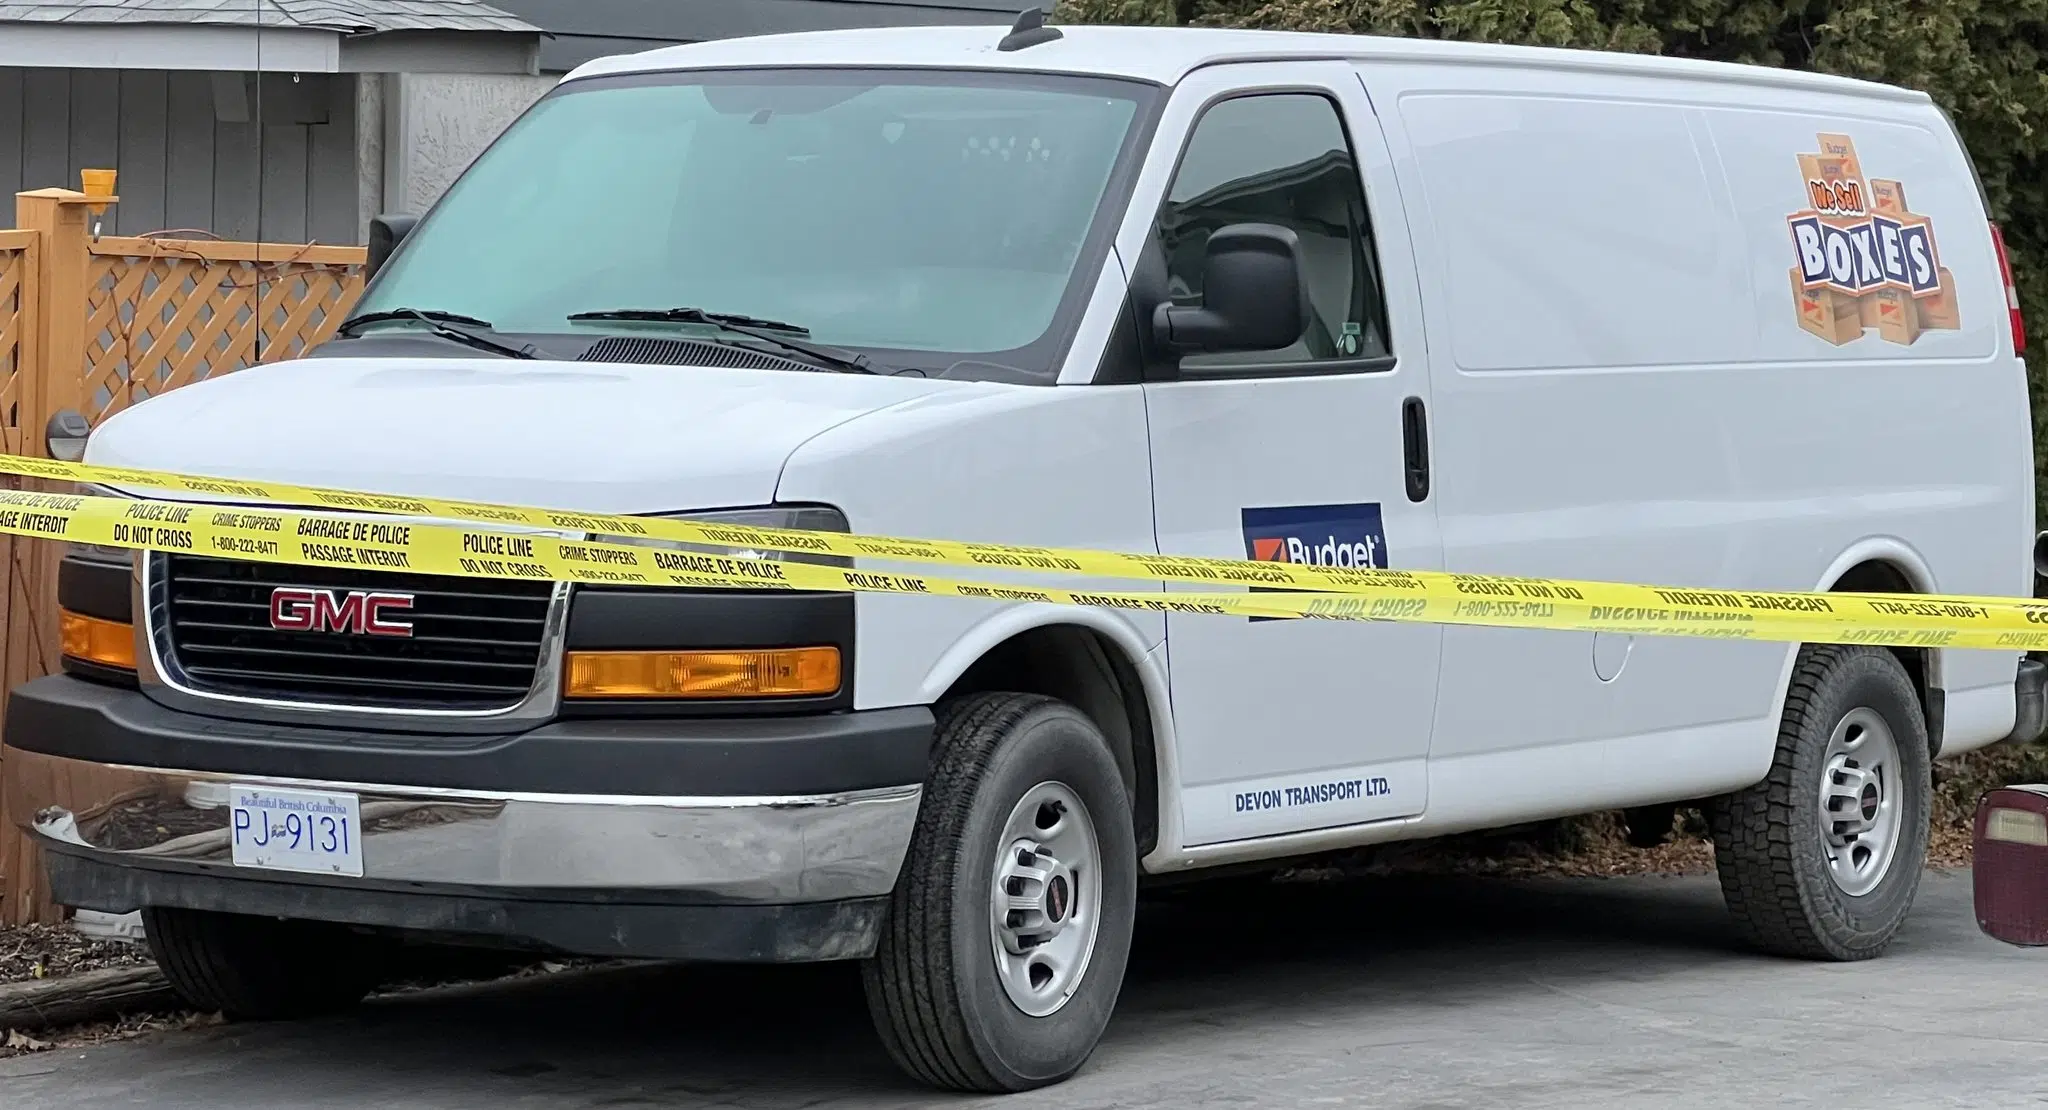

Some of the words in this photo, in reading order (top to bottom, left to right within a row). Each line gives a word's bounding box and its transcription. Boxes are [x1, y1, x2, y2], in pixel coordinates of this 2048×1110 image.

[1810, 181, 1836, 210] We
[1834, 182, 1864, 212] Sell
[1795, 223, 1931, 285] BOXES
[42, 496, 84, 511] POLICE
[125, 503, 165, 521] POLICE
[165, 506, 192, 524] LINE
[20, 512, 69, 534] INTERDIT
[211, 512, 240, 527] CRIME
[239, 515, 282, 531] STOPPERS
[298, 517, 351, 540] BARRAGE
[353, 522, 369, 541] DE
[371, 525, 410, 545] POLICE
[114, 523, 129, 542] DO
[132, 526, 154, 545] NOT
[156, 529, 192, 548] CROSS
[211, 536, 278, 555] 1-800-222-8477
[464, 533, 504, 555] POLICE
[506, 537, 534, 558] LINE
[301, 543, 356, 563] PASSAGE
[356, 548, 411, 568] INTERDIT
[559, 545, 589, 562] CRIME
[589, 548, 638, 566] STOPPERS
[654, 552, 717, 574] BARRAGE
[716, 558, 738, 575] DE
[736, 560, 786, 580] POLICE
[460, 558, 481, 574] DO
[481, 560, 507, 576] NOT
[507, 562, 553, 577] CROSS
[843, 572, 896, 590] POLICE
[894, 577, 932, 593] LINE
[270, 587, 415, 637] GMC
[240, 796, 276, 809] Beautiful
[279, 799, 305, 811] British
[306, 802, 347, 814] Columbia
[1235, 790, 1282, 812] DEVON
[1285, 780, 1362, 806] TRANSPORT
[1366, 777, 1391, 797] LTD.
